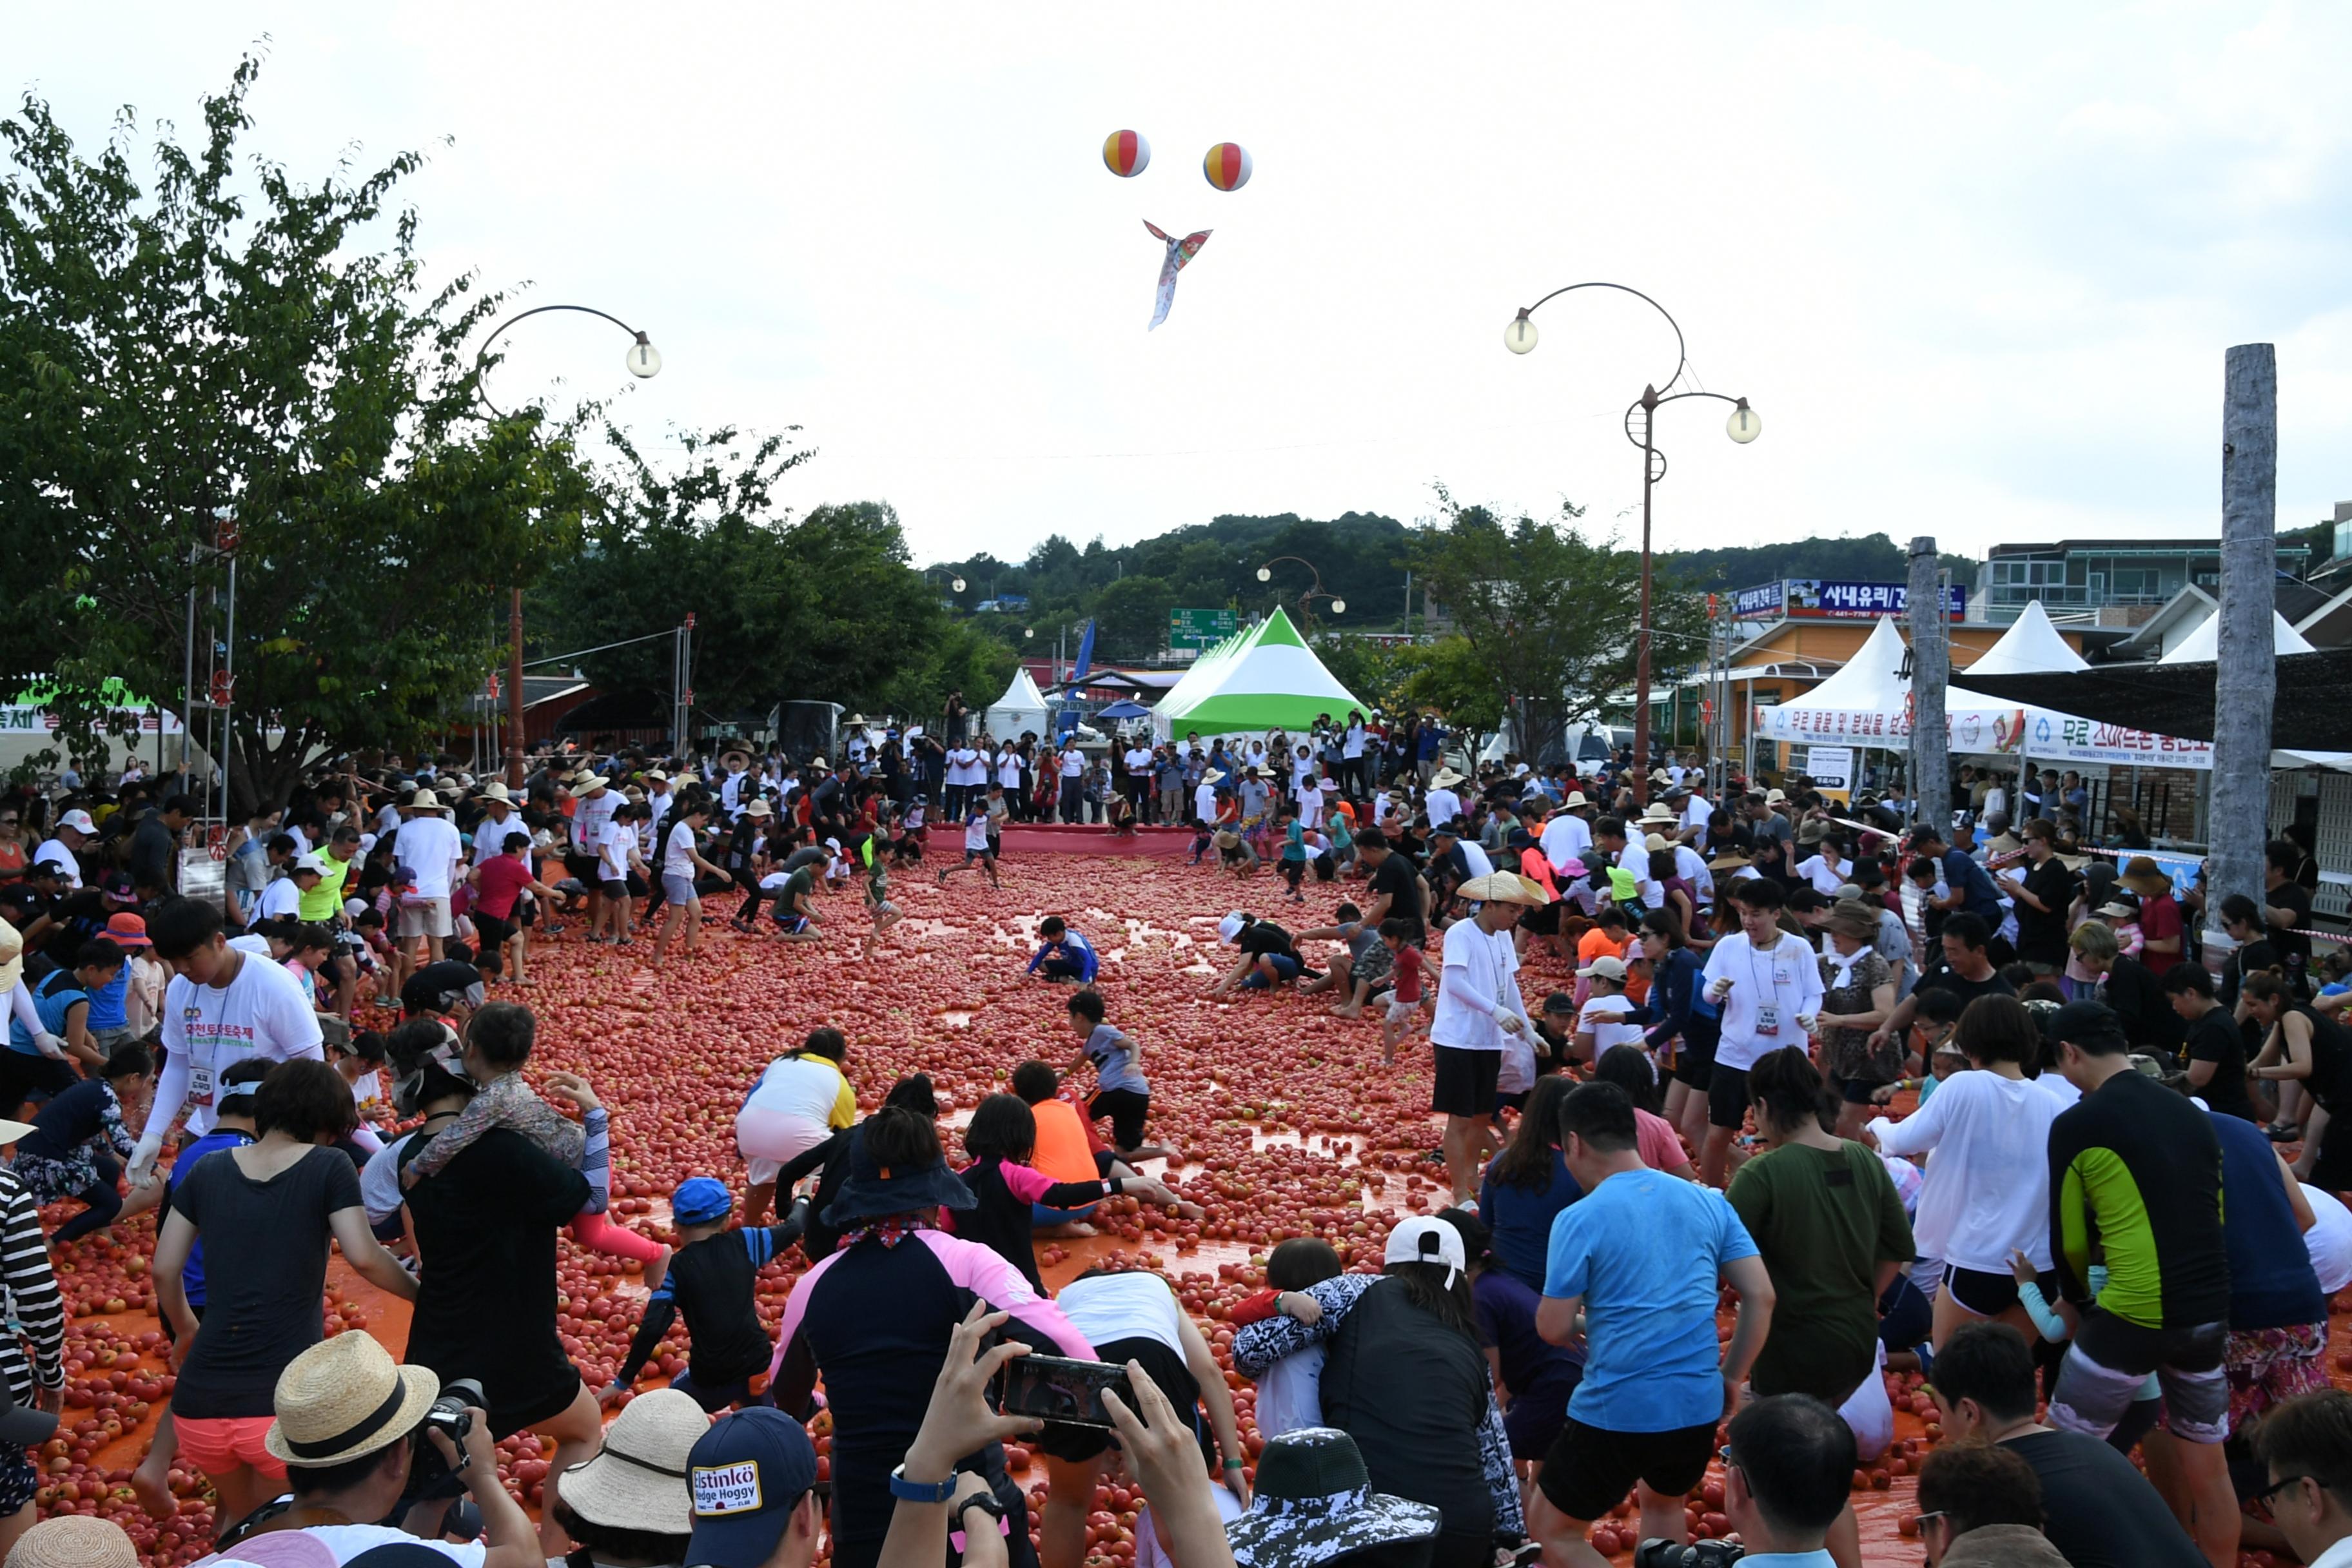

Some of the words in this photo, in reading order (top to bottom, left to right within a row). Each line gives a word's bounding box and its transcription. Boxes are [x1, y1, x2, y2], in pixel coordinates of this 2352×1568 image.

[1824, 585, 1908, 609] 사내유리/건
[1791, 710, 1809, 731] 무료
[1814, 712, 1832, 733] 물품
[1851, 712, 1884, 736] 분실물
[2063, 720, 2090, 746] 무료
[185, 1023, 254, 1040] 화천토마토축제
[720, 1486, 755, 1500] Hoggy
